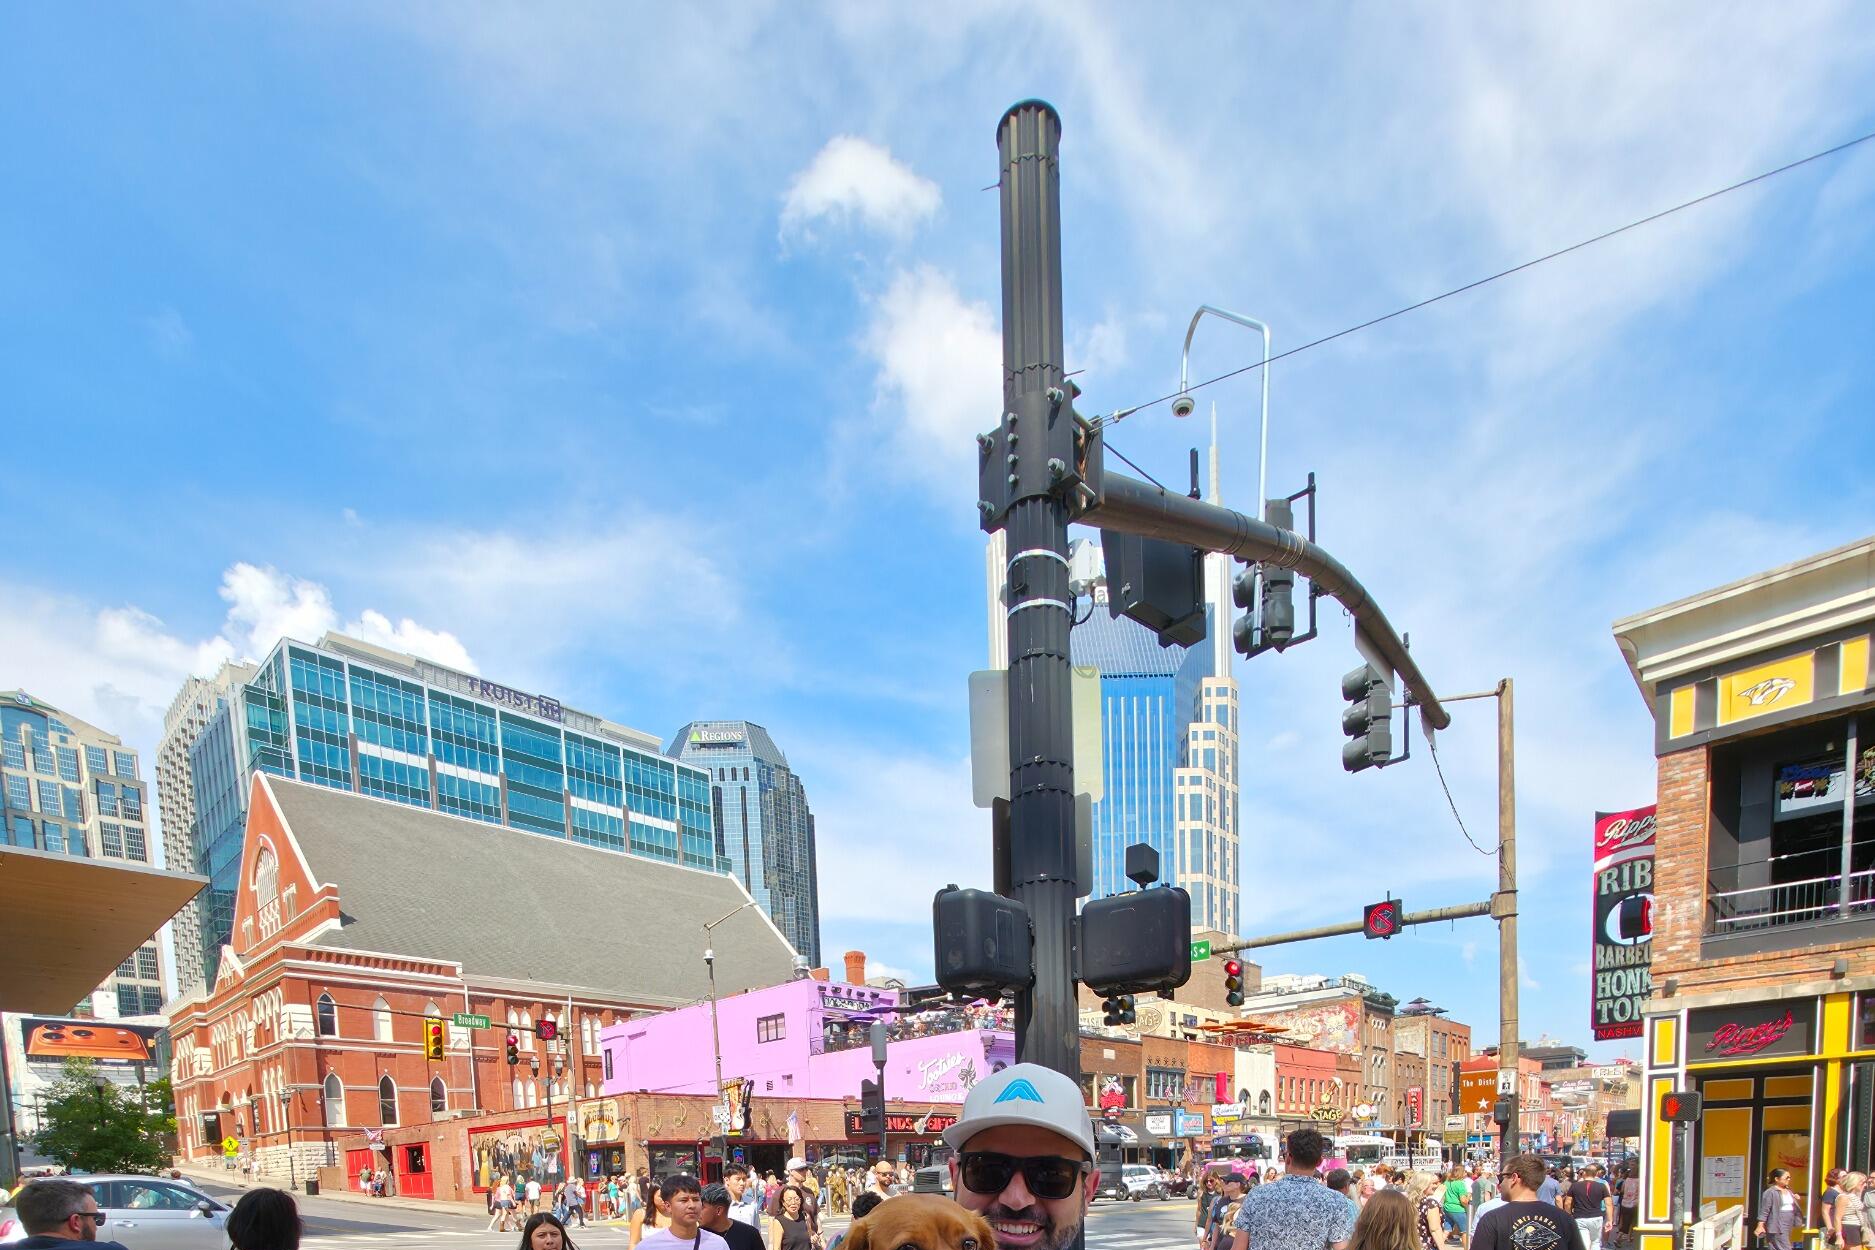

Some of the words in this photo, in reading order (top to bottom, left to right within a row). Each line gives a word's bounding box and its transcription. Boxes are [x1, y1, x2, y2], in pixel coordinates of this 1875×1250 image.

[468, 677, 541, 709] TRUIST
[701, 730, 742, 741] REGIONS
[1597, 815, 1656, 847] Ripp
[1600, 859, 1652, 895] RIB
[1595, 941, 1651, 970] BARBE
[1597, 966, 1653, 998] HONK
[1597, 995, 1650, 1023] TON
[458, 1014, 487, 1029] Broadway
[1598, 1026, 1640, 1038] NASHV
[1478, 1078, 1495, 1086] Distr
[854, 1116, 913, 1130] LNDS
[1311, 1108, 1344, 1120] STAGE
